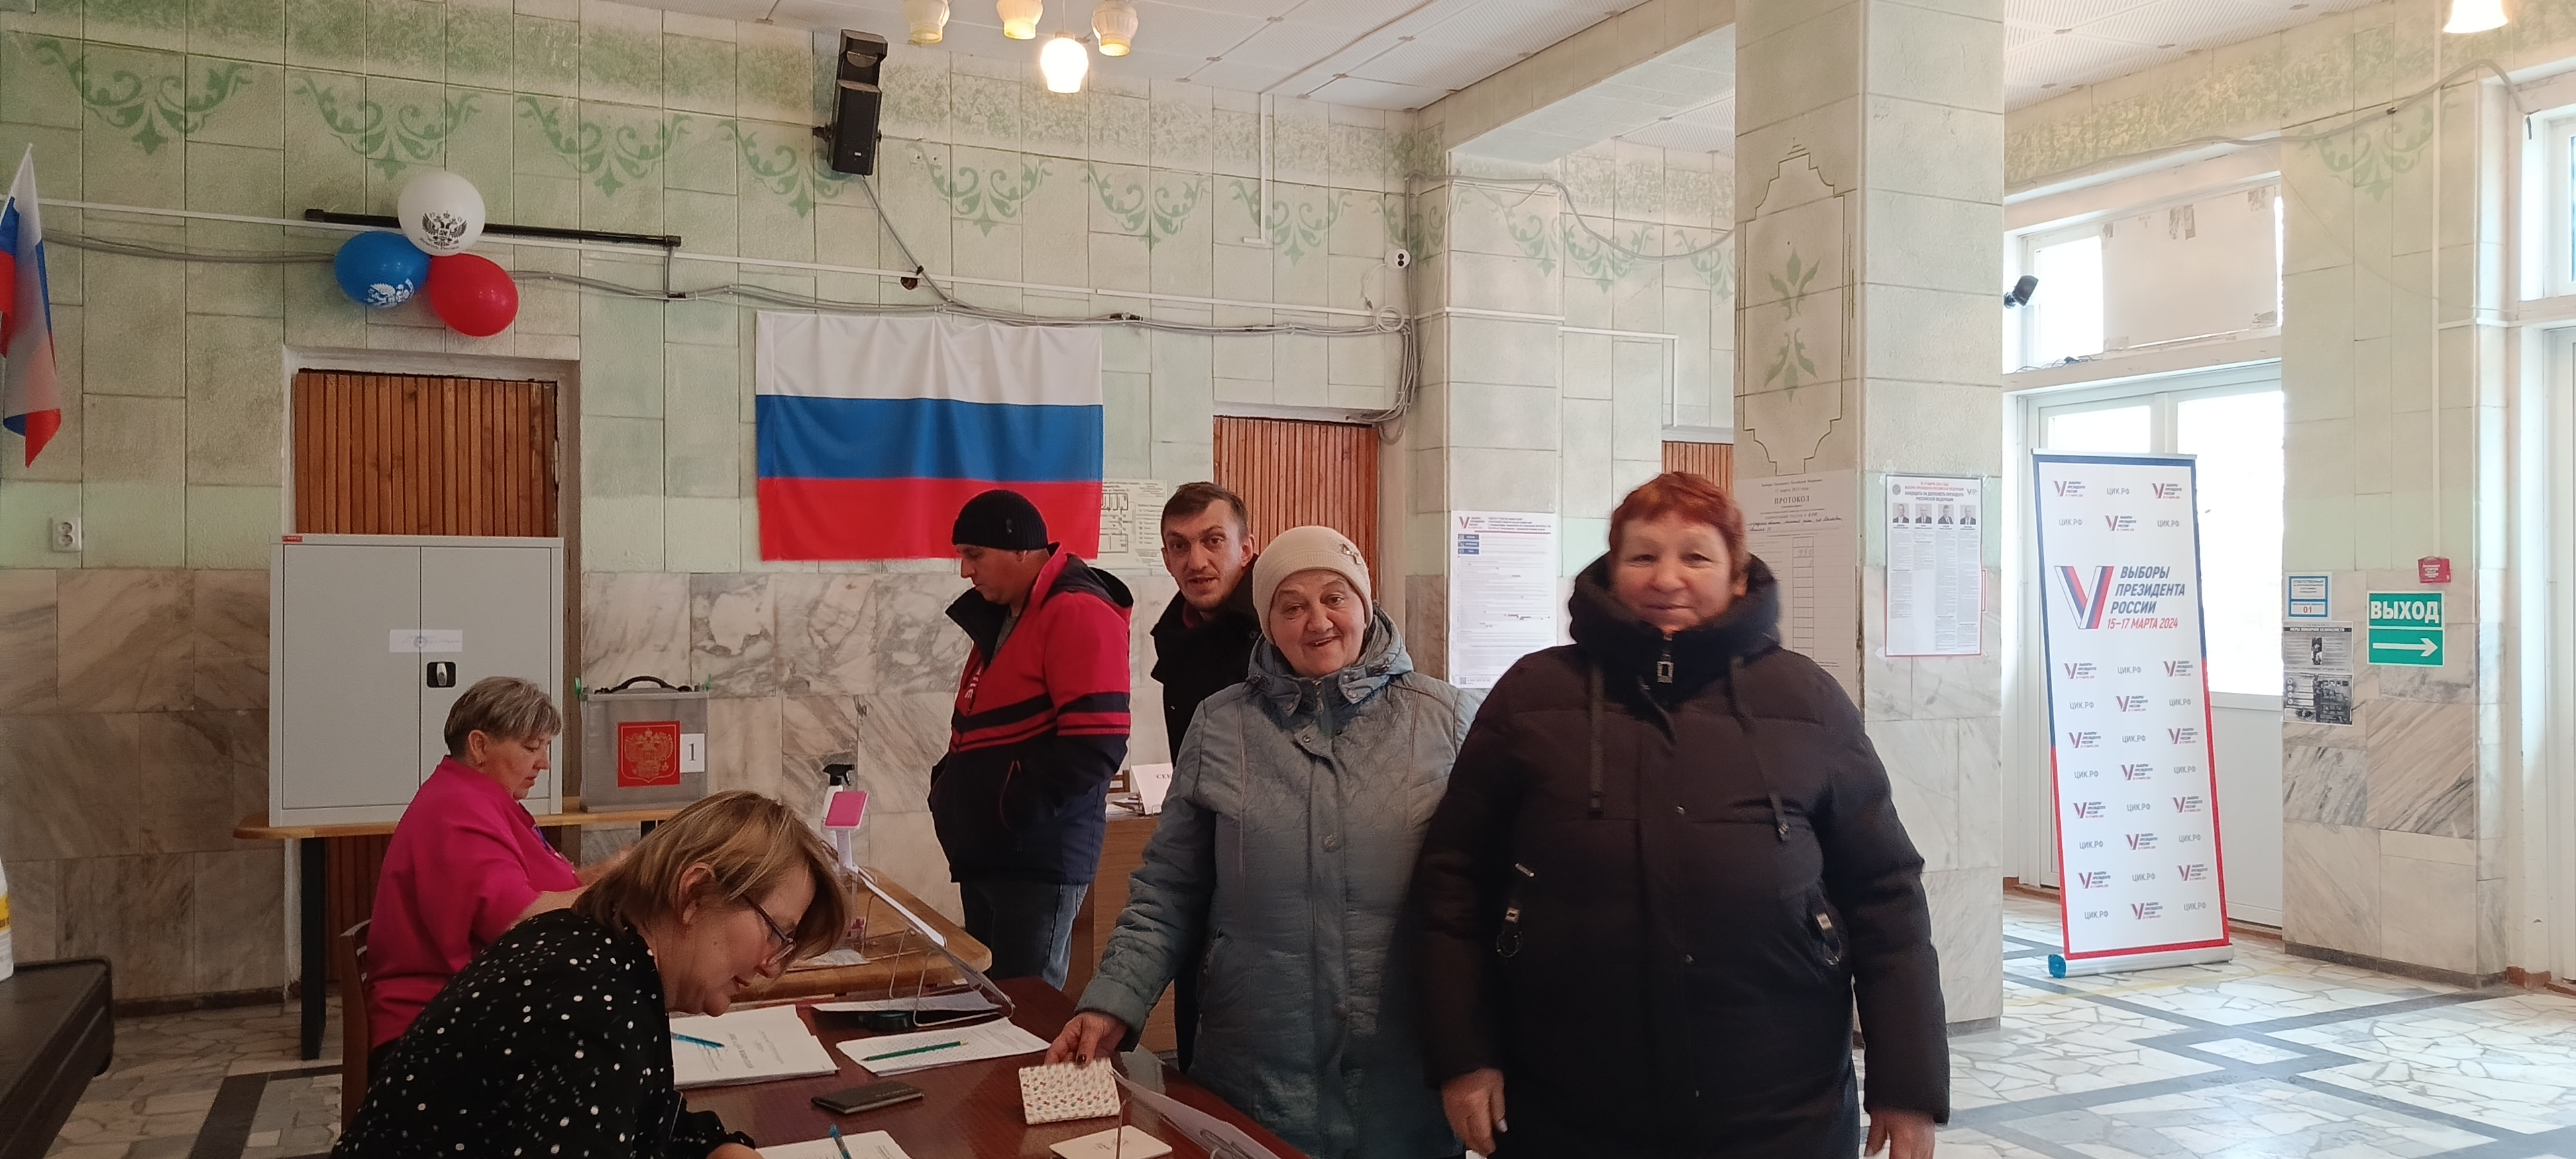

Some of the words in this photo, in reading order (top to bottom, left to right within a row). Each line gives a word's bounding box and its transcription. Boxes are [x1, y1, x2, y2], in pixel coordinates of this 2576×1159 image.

[2106, 488, 2130, 496] ЦИК.РФ
[1774, 496, 1810, 504] ПРОТОКОЛ
[2059, 518, 2083, 527] ЦИК.РФ
[2157, 520, 2180, 528] ЦИК.РФ
[2119, 565, 2171, 580] ВЫБОРЫ
[2114, 583, 2186, 598] ПРЕЗИДЕНТА
[2110, 600, 2157, 614] РОССИИ
[2303, 606, 2312, 614] 01
[2371, 601, 2439, 624] ВЫХОД
[2131, 617, 2158, 629] МАРТА
[2159, 617, 2178, 629] 2024
[2117, 666, 2142, 675] ЦИК.РФ
[2070, 701, 2094, 710] ЦИК.РФ
[2169, 698, 2192, 707] ЦИК.РФ
[2122, 734, 2146, 744] ЦИК.РФ
[689, 743, 696, 762] 1
[2074, 770, 2099, 779] ЦИК.РФ
[2174, 765, 2196, 775] ЦИК.РФ
[2127, 803, 2151, 812] ЦИК.РФ
[2178, 833, 2202, 843] ЦИК.РФ
[2079, 840, 2104, 850] ЦИК.РФ
[2131, 873, 2156, 883] ЦИК.РФ
[2183, 901, 2207, 912] ЦИК.РФ
[2084, 910, 2109, 920] ЦИК.РФ
